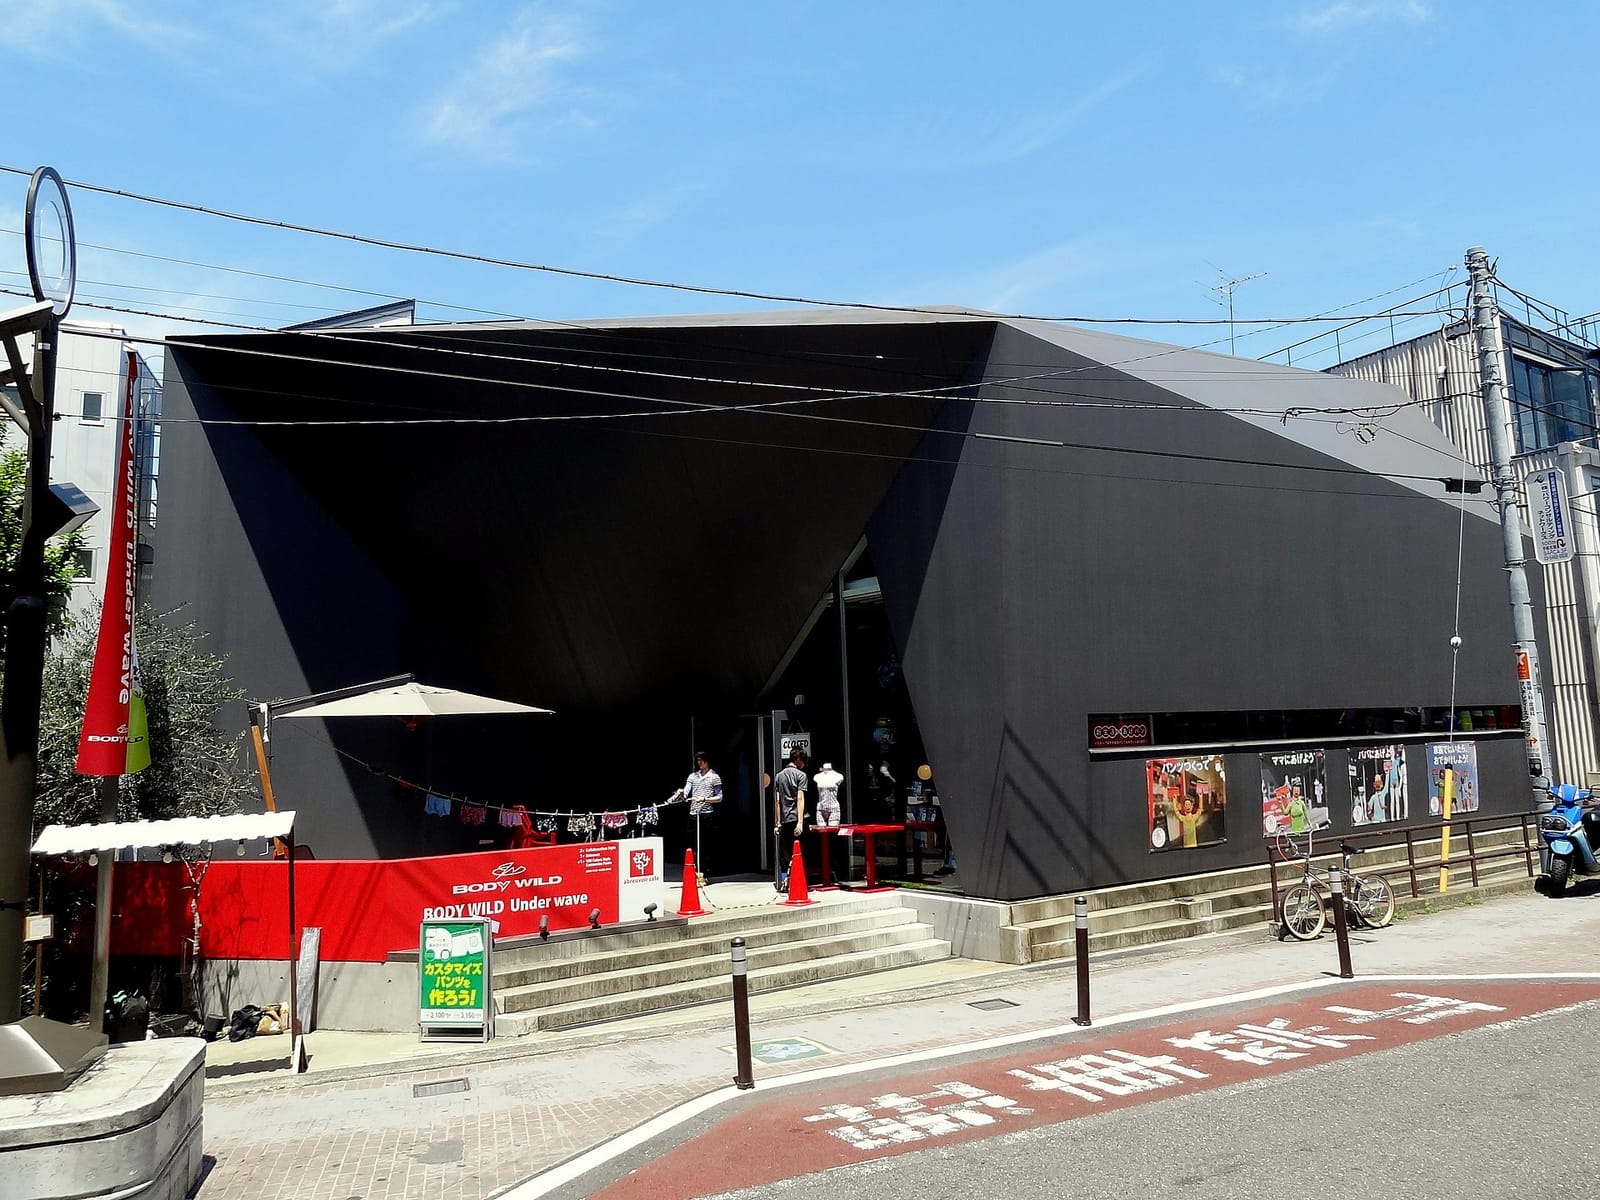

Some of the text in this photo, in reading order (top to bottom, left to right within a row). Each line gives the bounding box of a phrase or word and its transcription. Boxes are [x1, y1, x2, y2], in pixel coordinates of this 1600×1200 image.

[124, 542, 135, 625] Under
[119, 631, 131, 705] wave
[783, 739, 809, 749] CLOSED
[452, 875, 563, 895] BODY WILD
[423, 892, 589, 920] BODY WILD Under wave
[424, 962, 483, 976] カスタマイズ
[435, 975, 471, 988] パンツを
[429, 988, 477, 1007] 作ろう!
